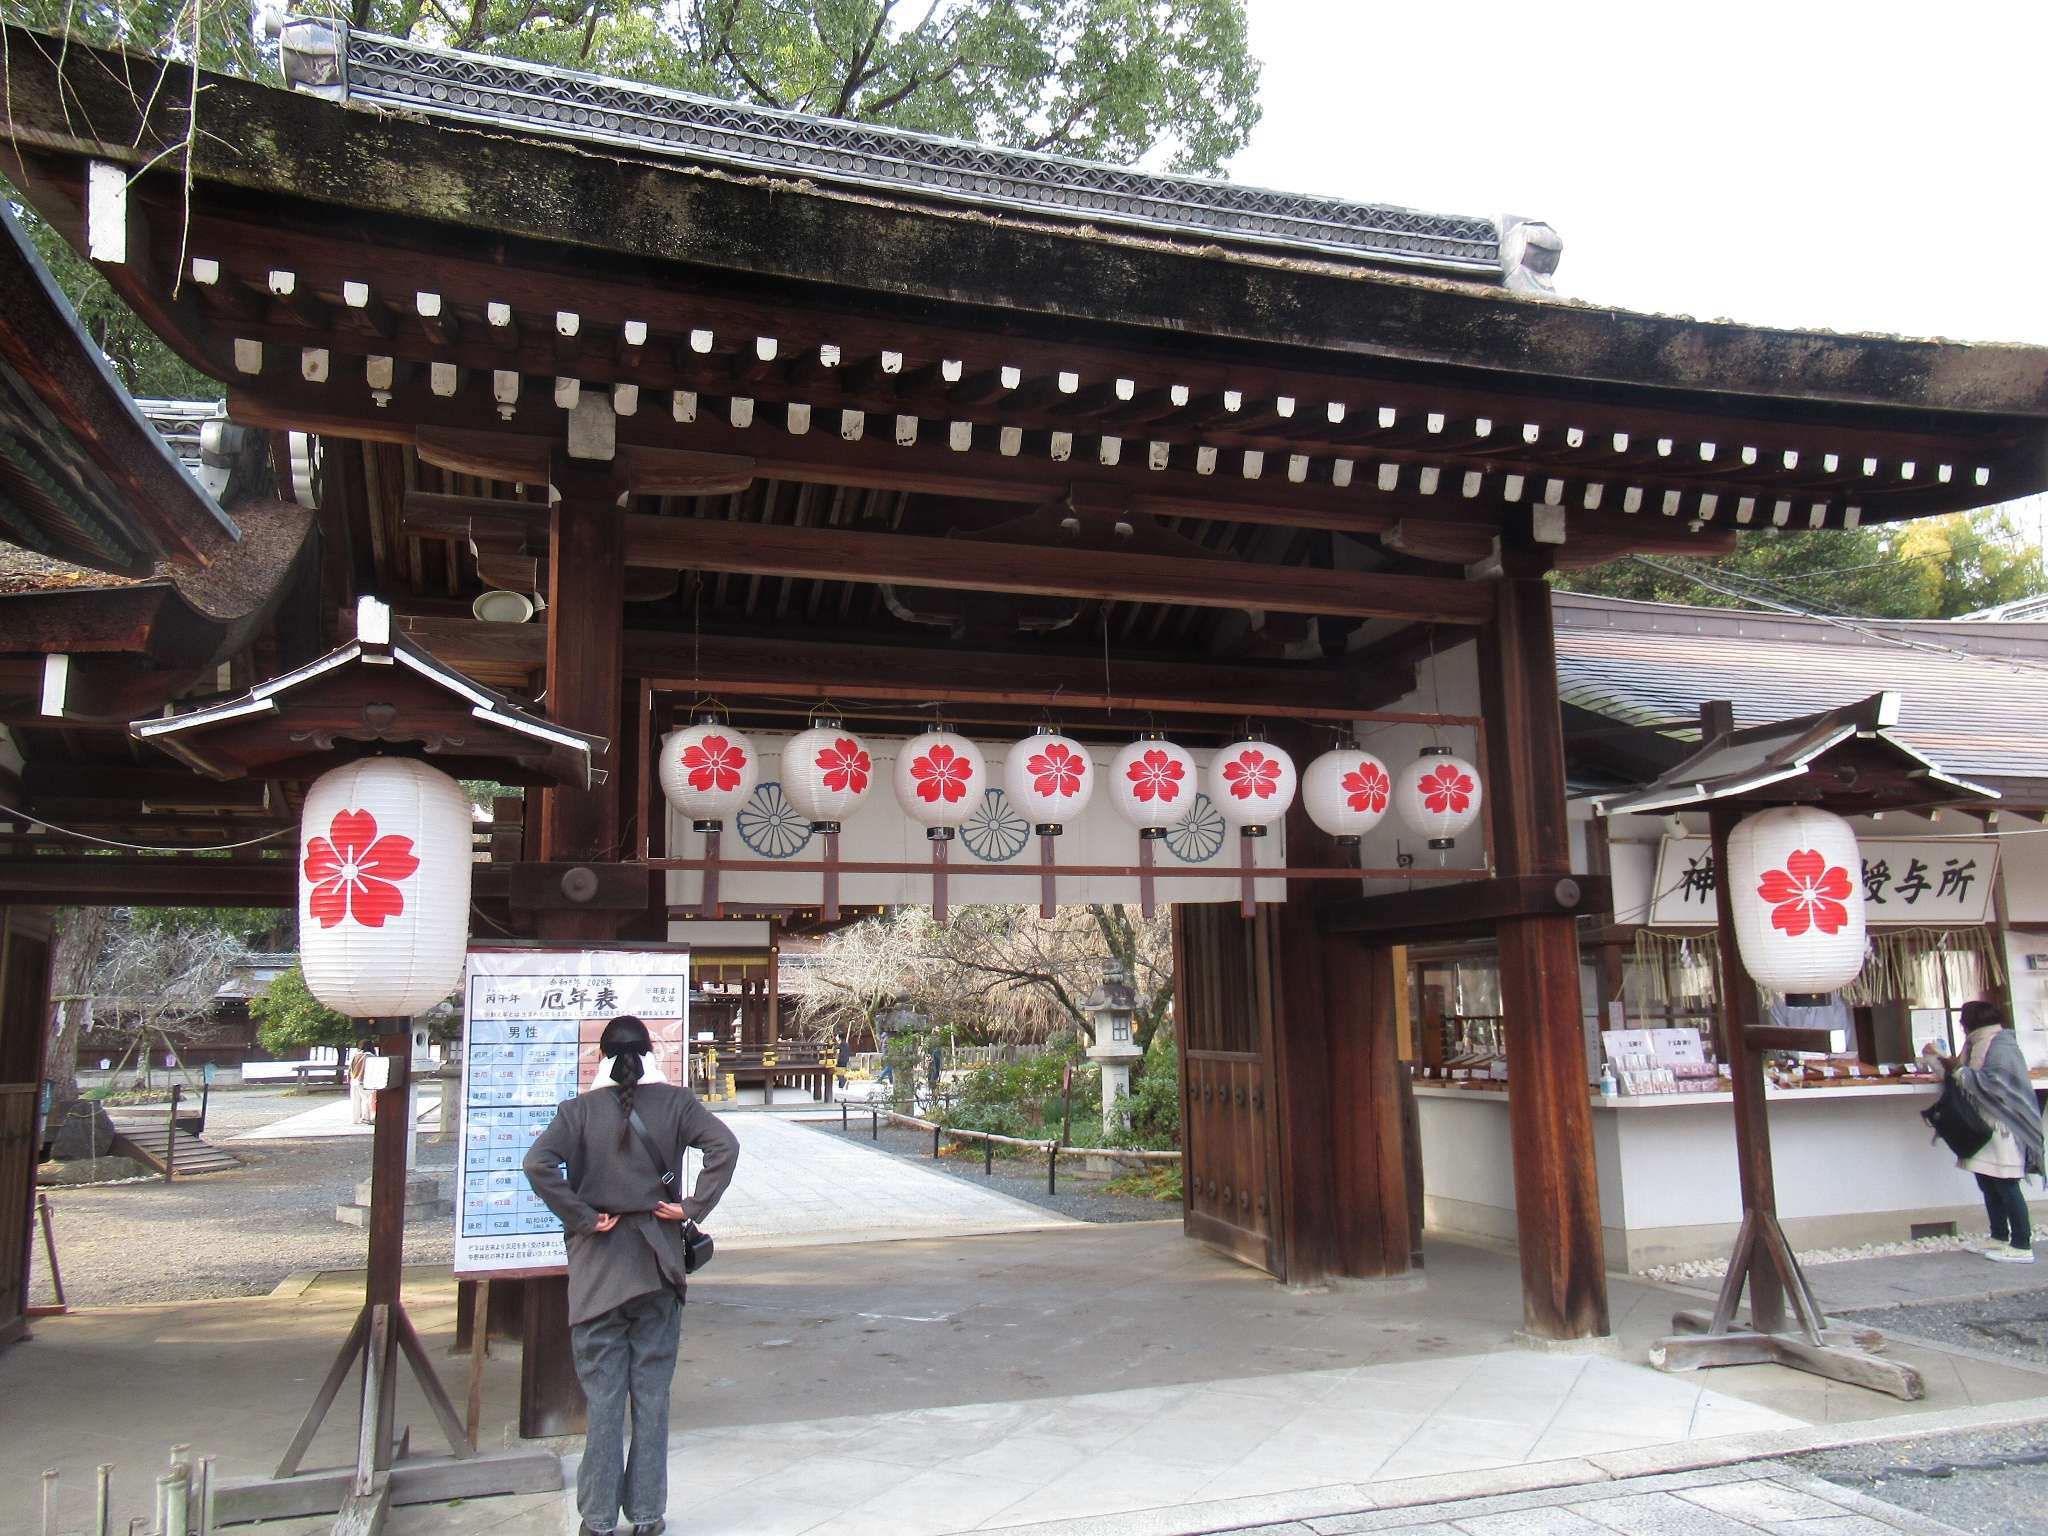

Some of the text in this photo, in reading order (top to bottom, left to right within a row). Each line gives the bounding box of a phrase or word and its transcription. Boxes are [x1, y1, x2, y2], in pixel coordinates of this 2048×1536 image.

[540, 987, 618, 1010] 厄年表
[508, 1026, 538, 1039] 男性
